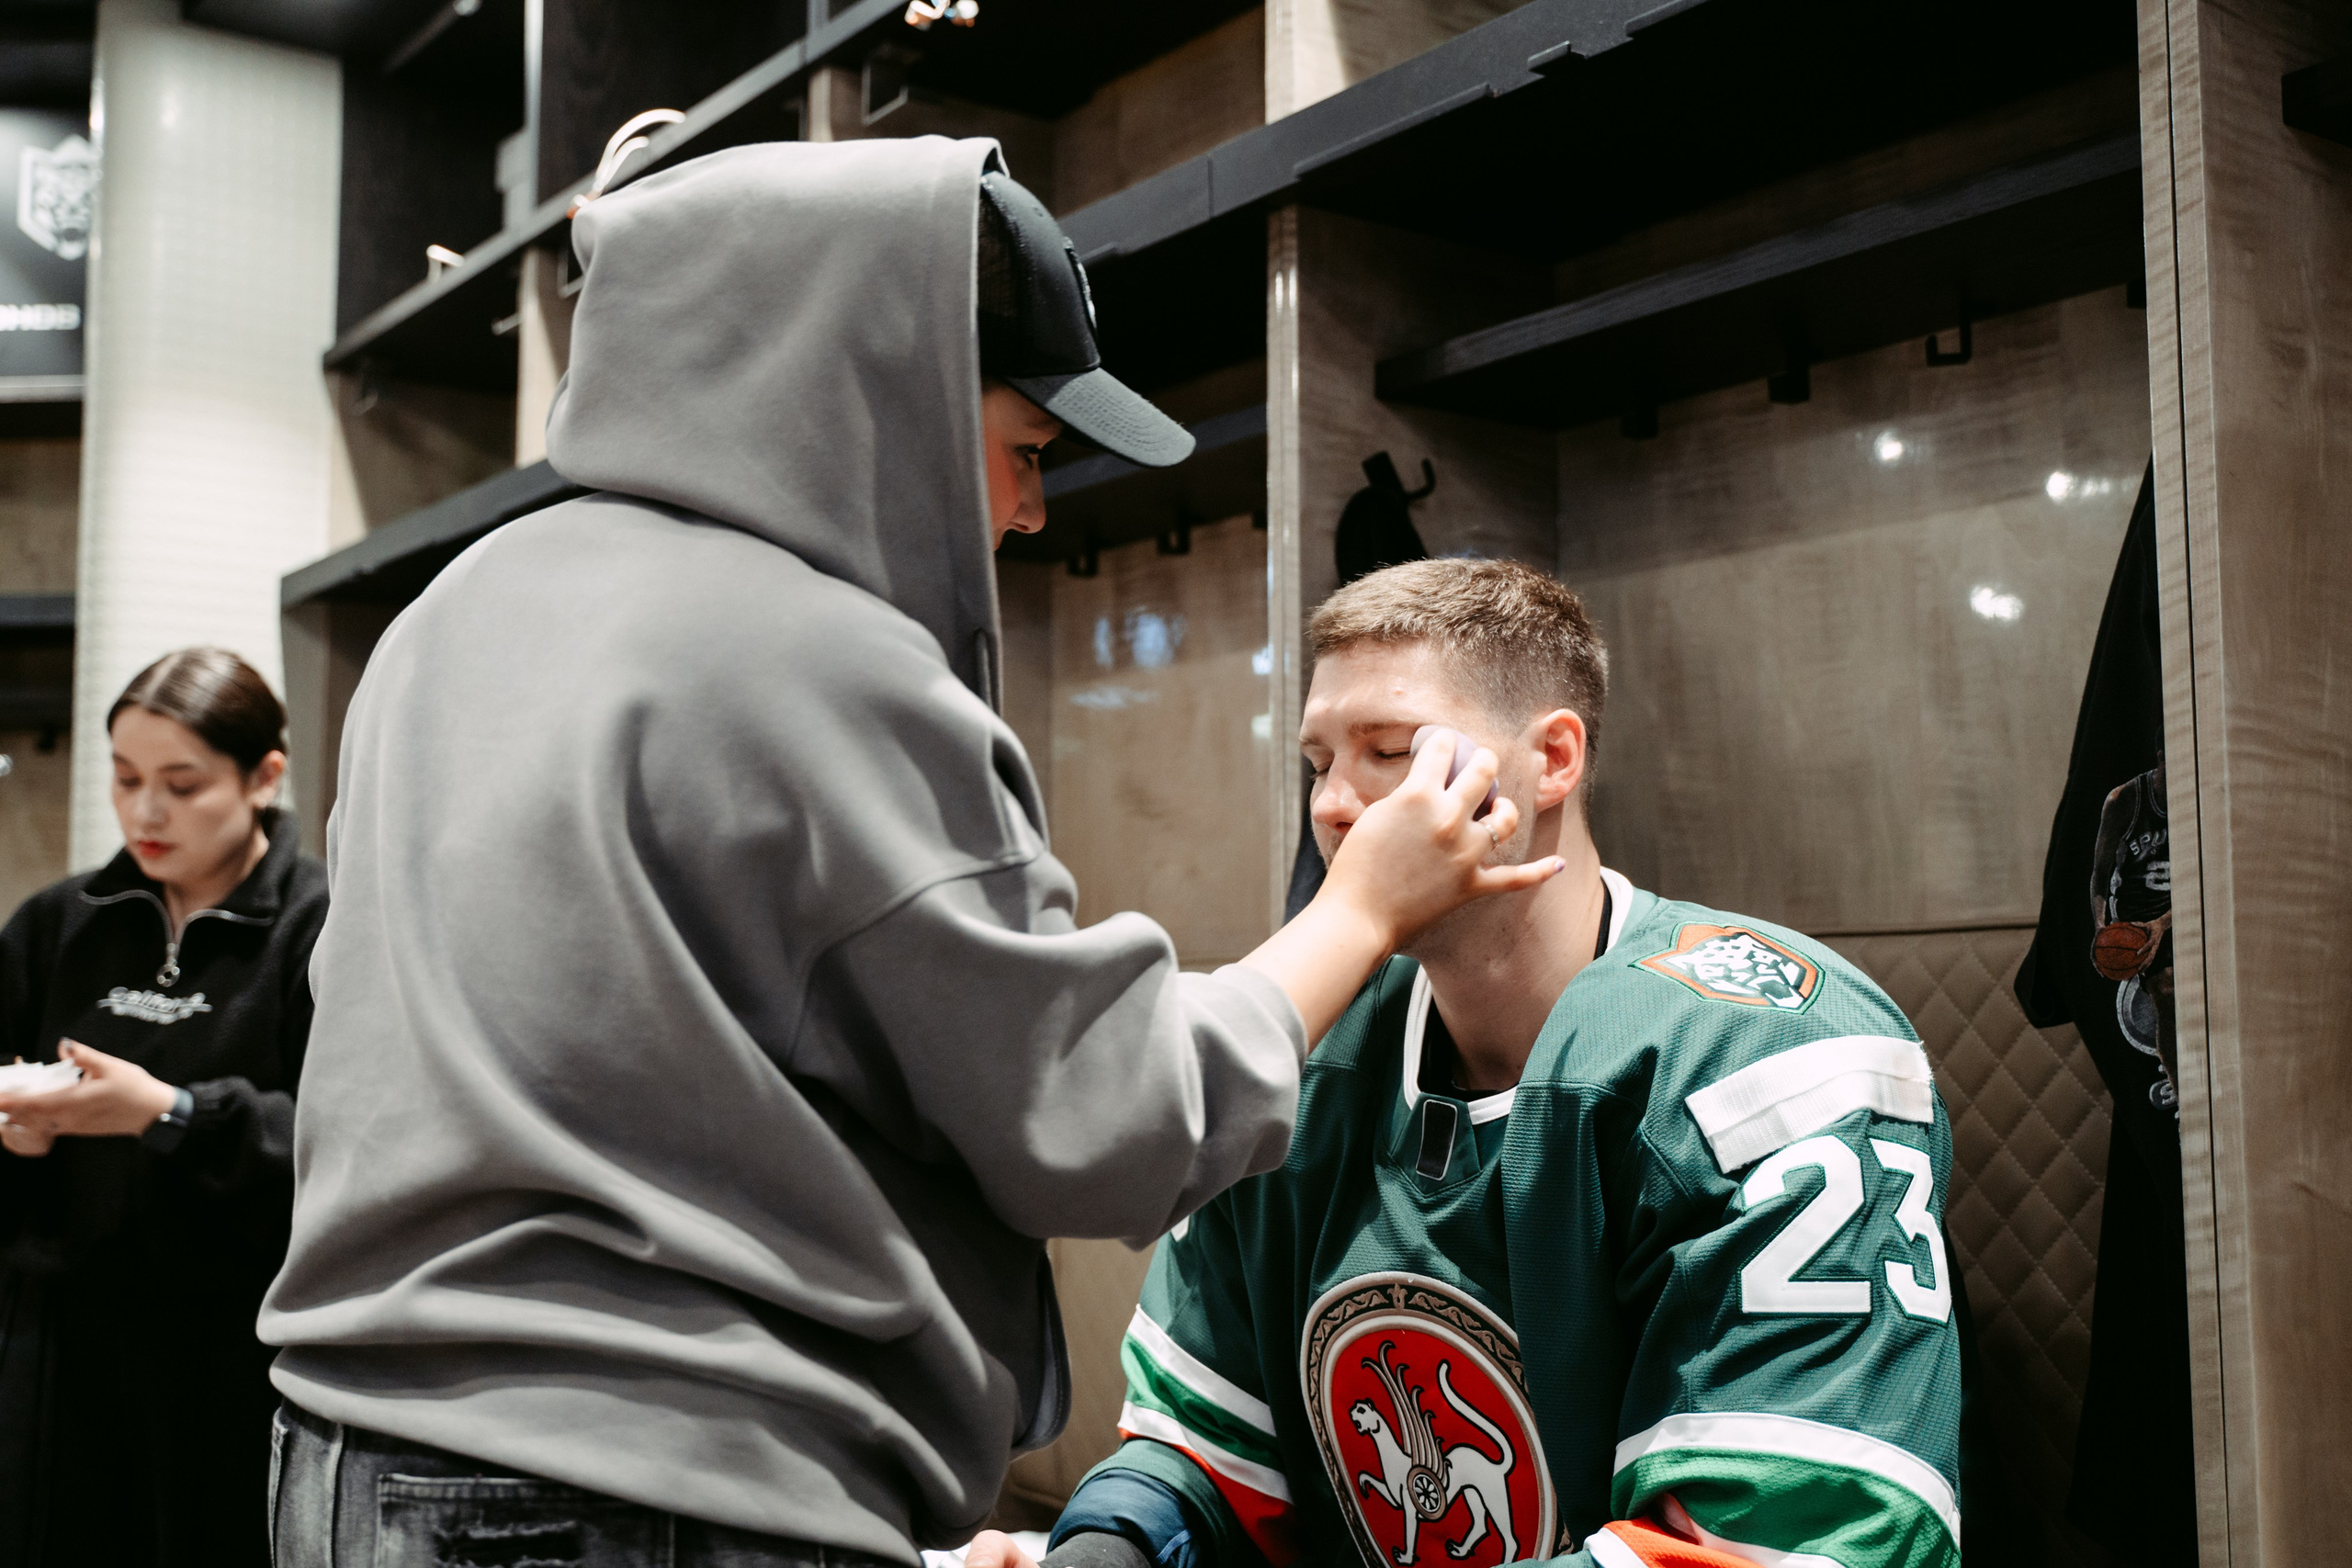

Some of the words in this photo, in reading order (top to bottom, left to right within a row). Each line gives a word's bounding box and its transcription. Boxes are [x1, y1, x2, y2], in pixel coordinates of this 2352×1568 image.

[2130, 829, 2167, 855] SPU
[2145, 861, 2170, 891] 2
[1742, 1134, 1951, 1323] 23
